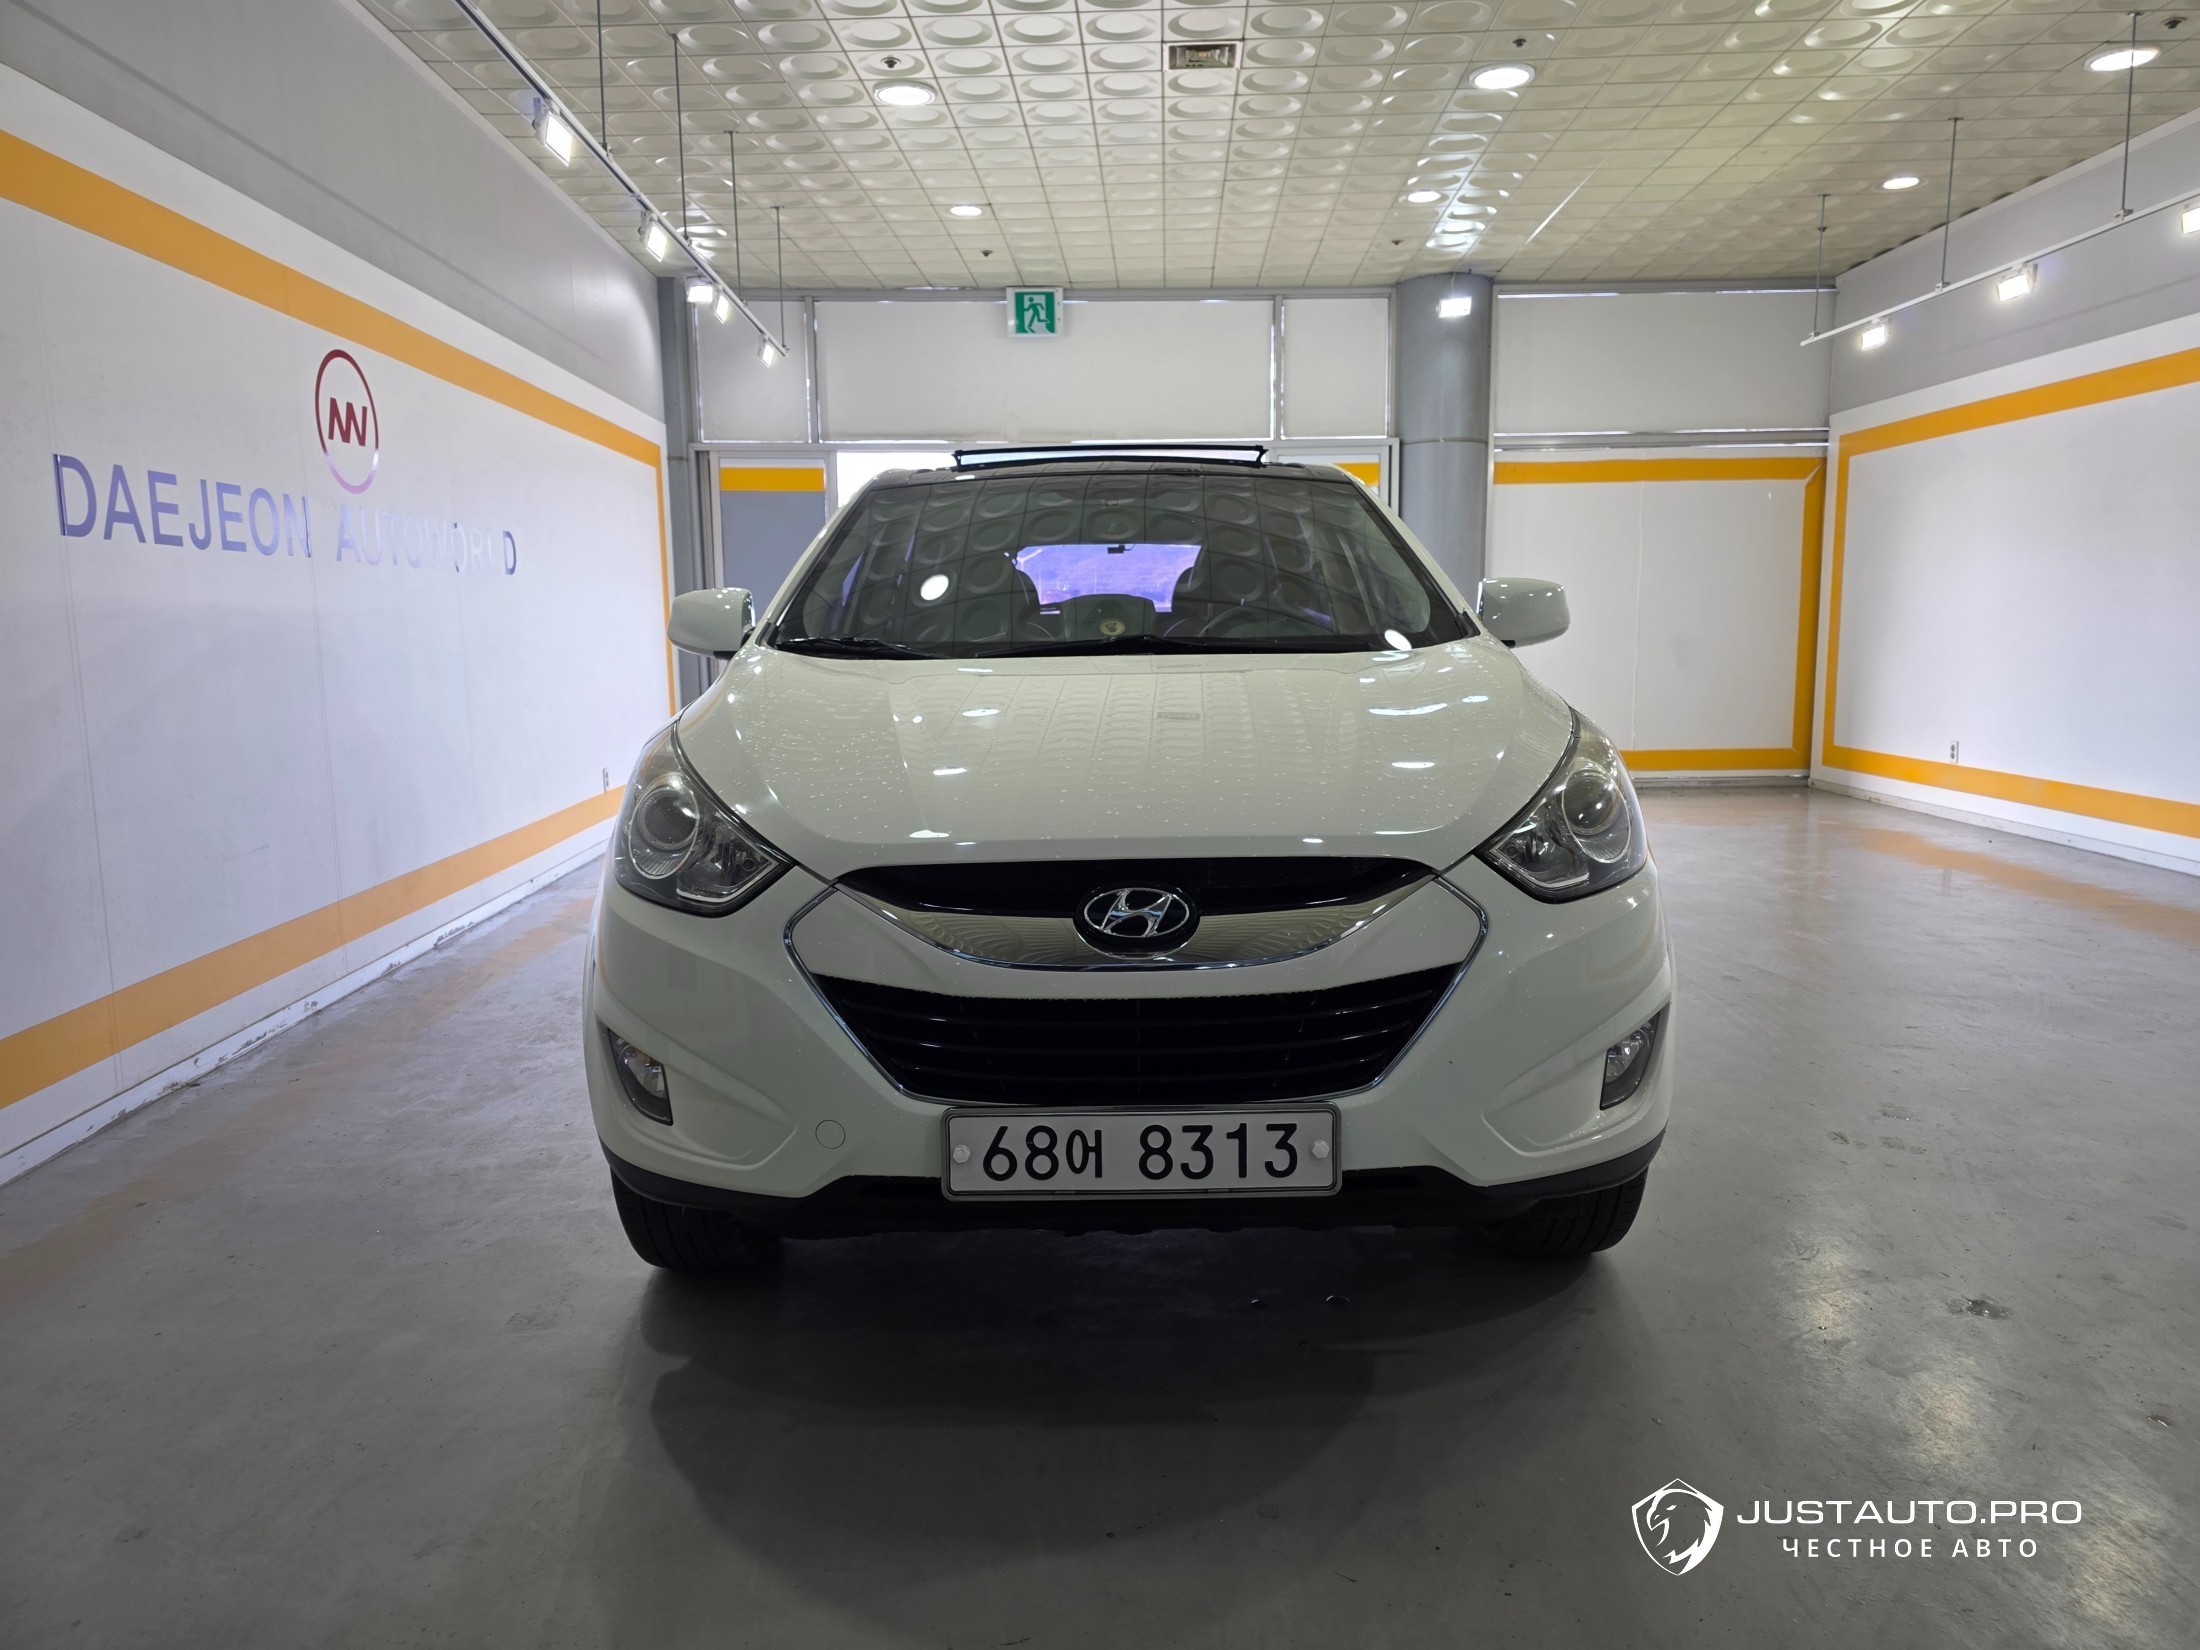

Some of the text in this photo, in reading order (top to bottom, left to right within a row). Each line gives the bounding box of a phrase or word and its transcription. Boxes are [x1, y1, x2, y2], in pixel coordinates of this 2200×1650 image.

[53, 453, 517, 576] DAEJEON AUTOWORLD
[982, 1122, 1298, 1182] 68어 8313
